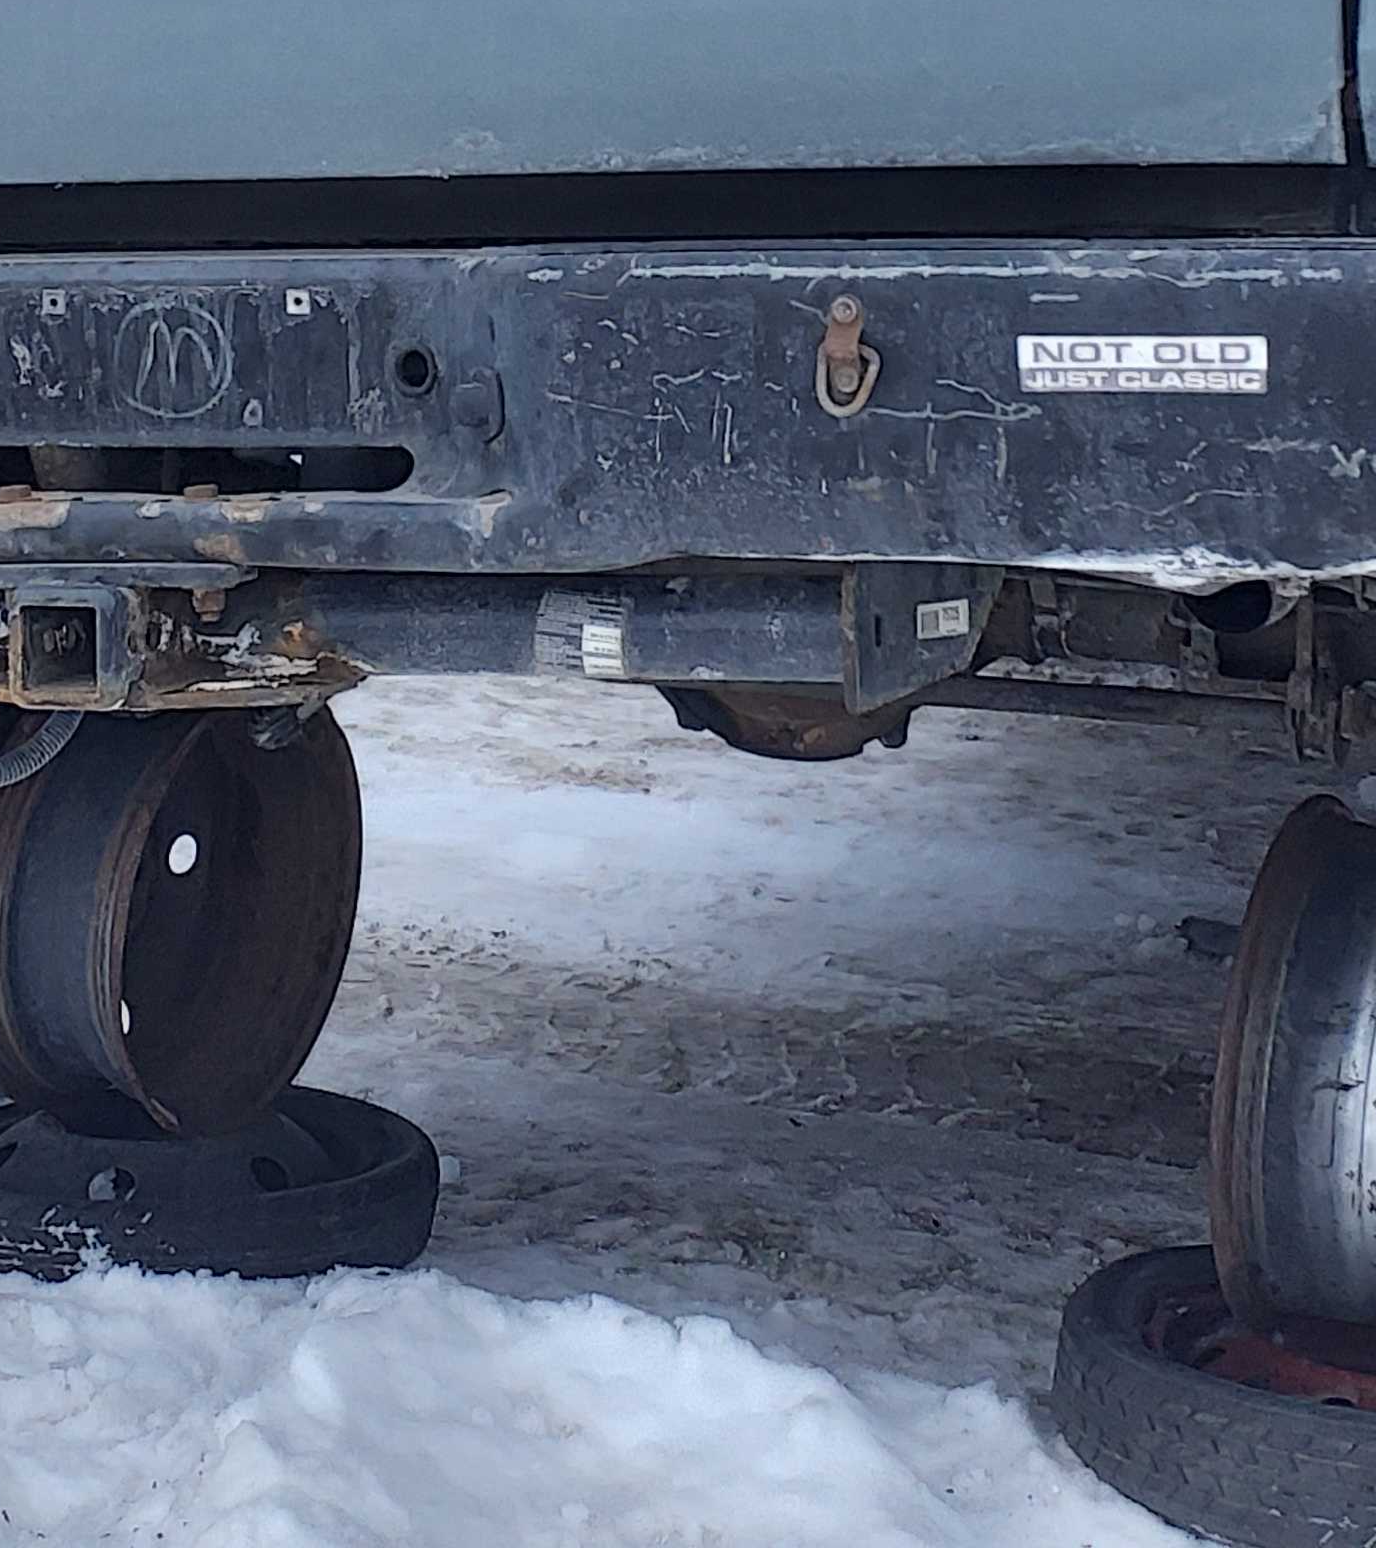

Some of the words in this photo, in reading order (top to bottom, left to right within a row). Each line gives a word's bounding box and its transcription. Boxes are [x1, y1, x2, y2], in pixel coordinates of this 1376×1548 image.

[1032, 342, 1132, 364] NOT
[1153, 342, 1252, 364] OLD
[1026, 371, 1109, 390] JUST
[1117, 371, 1261, 390] CLASSIC
